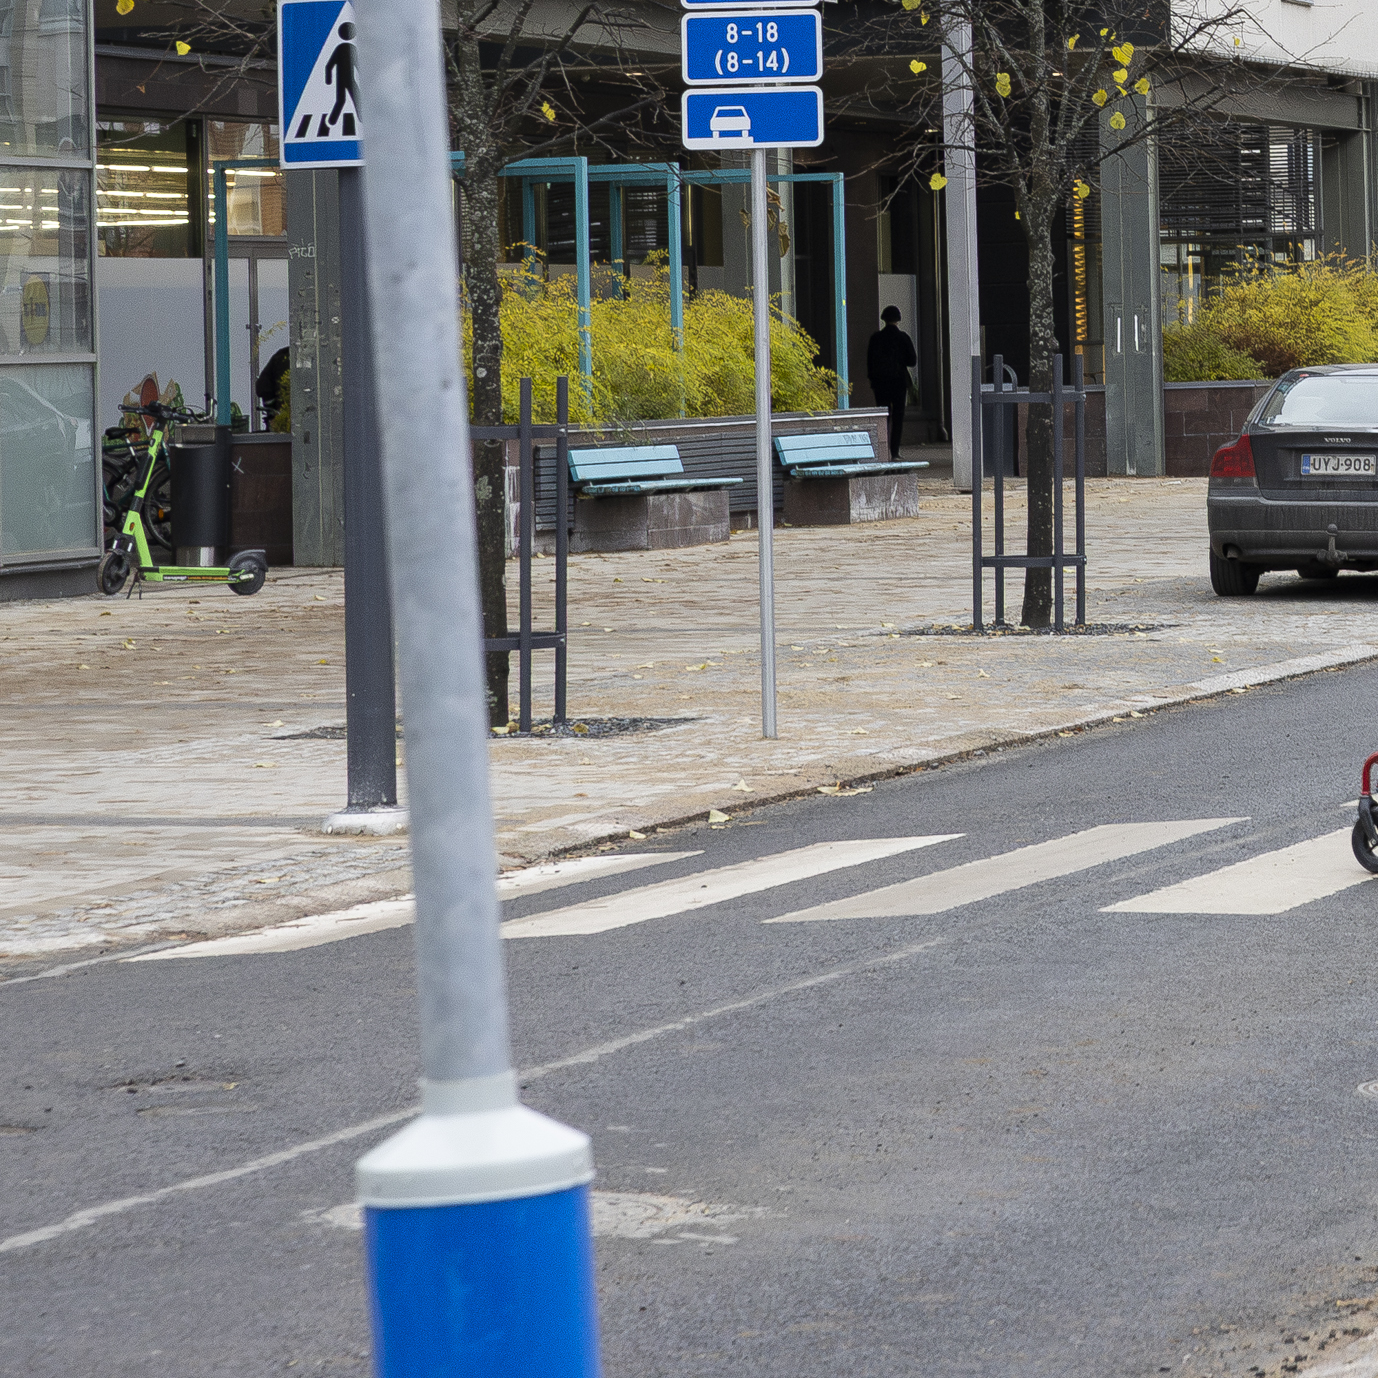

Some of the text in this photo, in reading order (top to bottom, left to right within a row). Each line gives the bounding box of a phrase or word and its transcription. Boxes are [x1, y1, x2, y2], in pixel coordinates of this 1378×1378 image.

[726, 22, 778, 43] 8-18
[715, 47, 790, 75] (8-14)
[1312, 457, 1371, 472] UYJ-908
